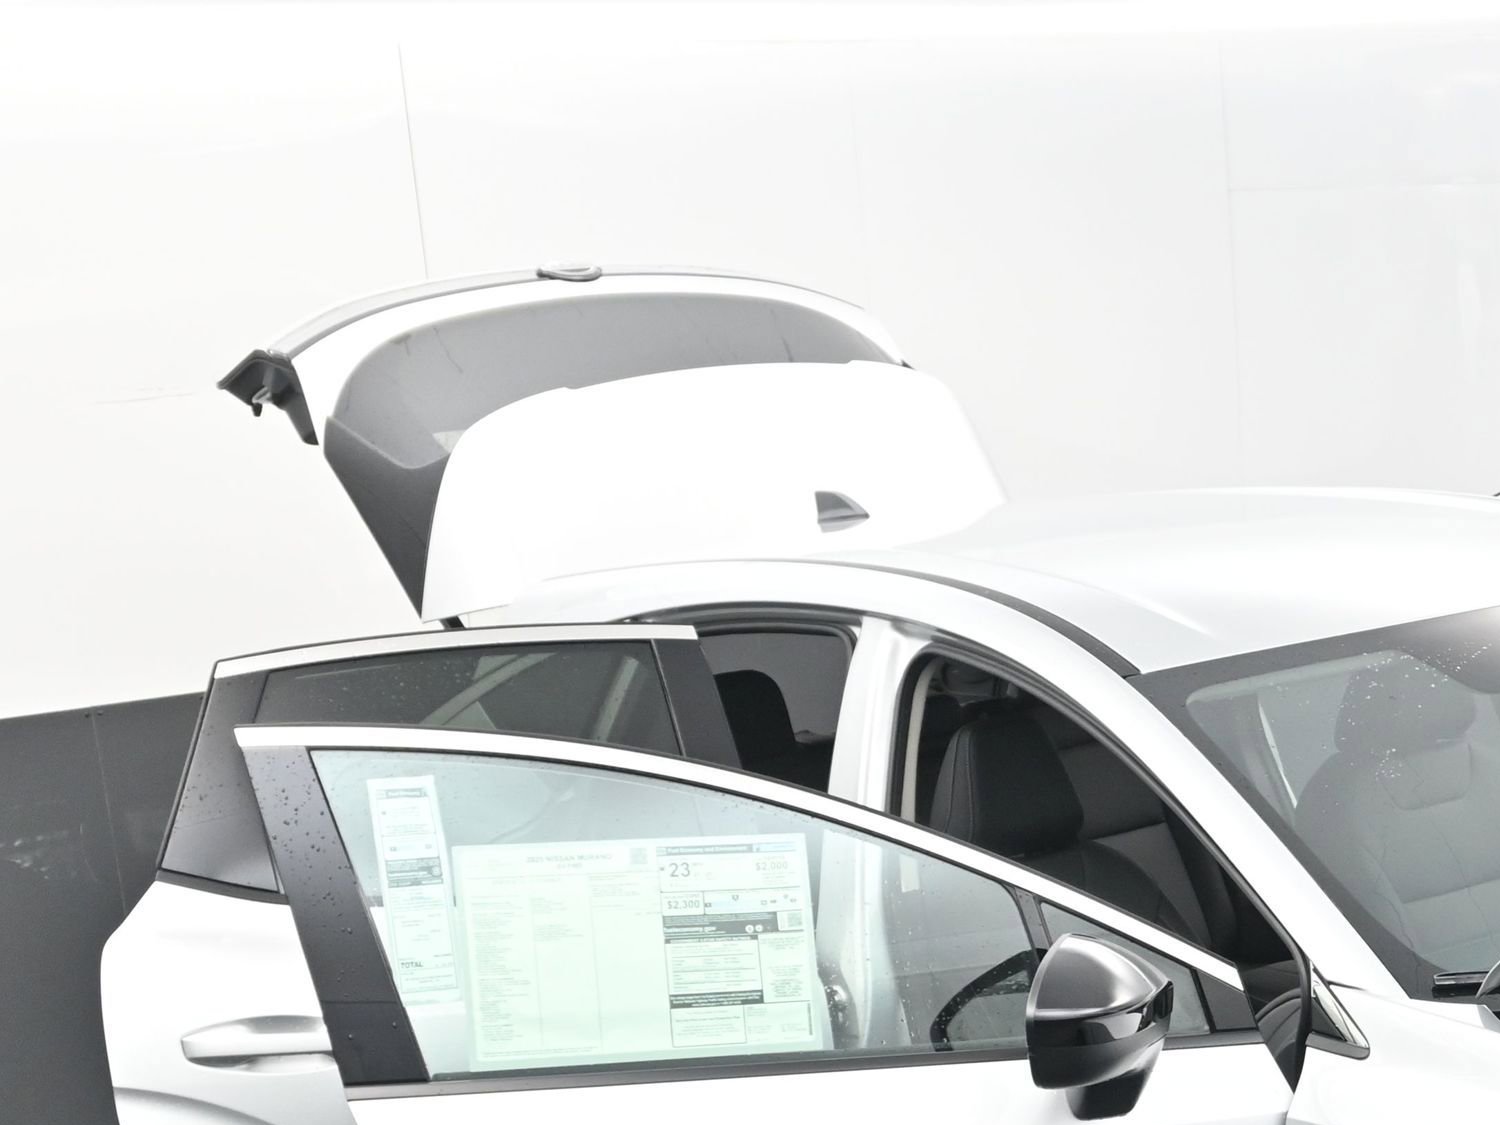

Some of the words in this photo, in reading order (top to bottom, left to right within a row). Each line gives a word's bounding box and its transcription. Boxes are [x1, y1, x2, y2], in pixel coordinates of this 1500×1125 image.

[668, 861, 691, 877] 23
[754, 860, 789, 873] $2,000
[667, 898, 701, 911] $2,300
[400, 960, 425, 969] TOTAL
